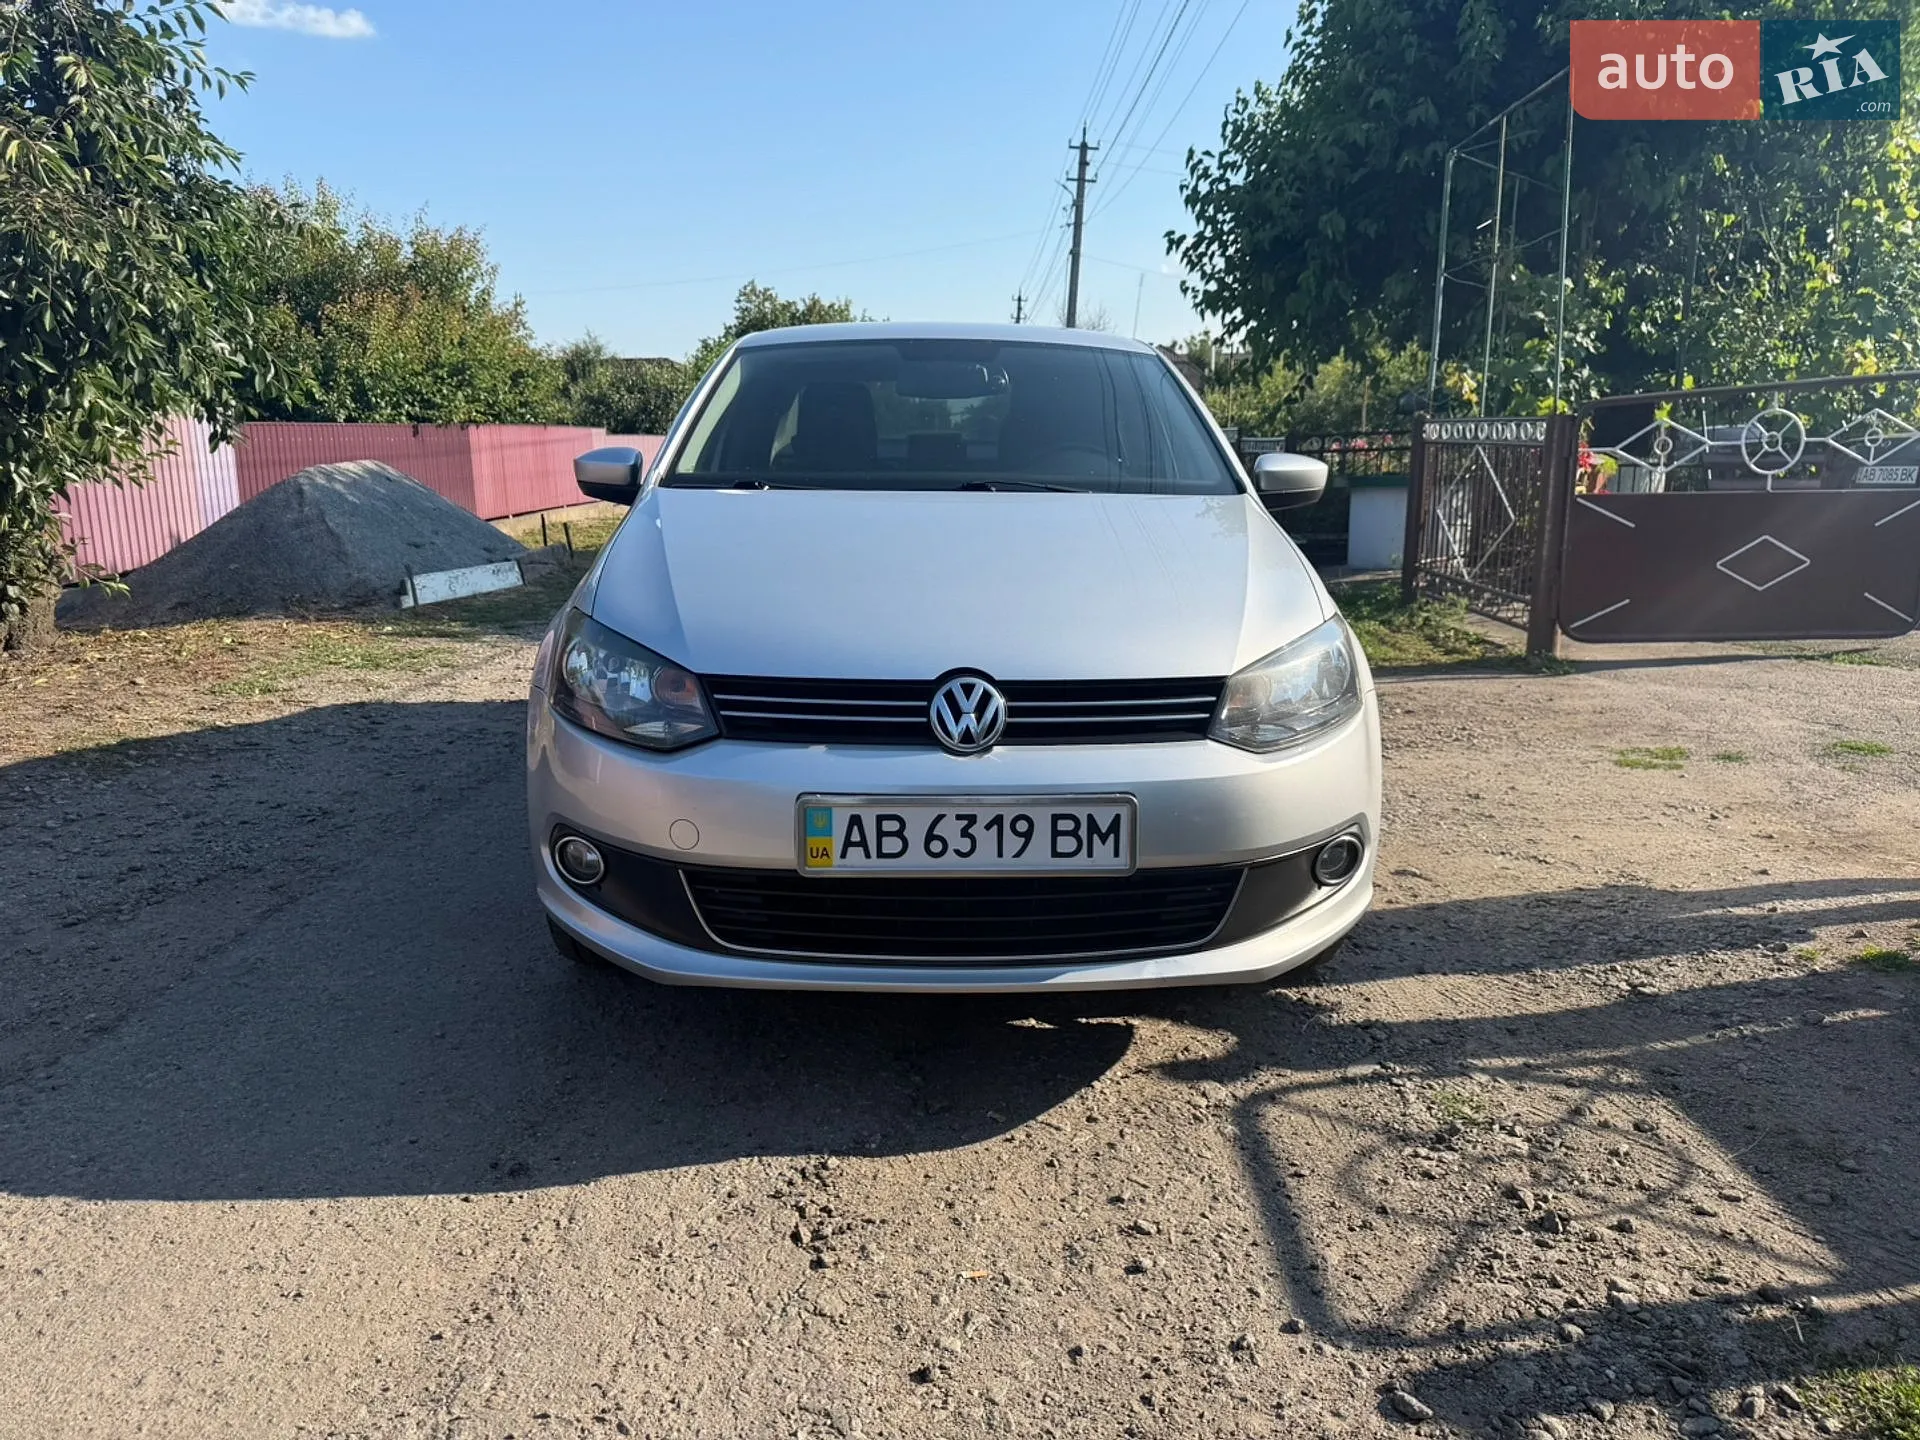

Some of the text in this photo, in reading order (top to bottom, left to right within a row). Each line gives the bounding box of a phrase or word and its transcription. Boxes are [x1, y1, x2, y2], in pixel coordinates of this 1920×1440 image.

[1900, 467, 1917, 481] BK
[839, 813, 1122, 859] AB 6319 BM
[809, 846, 830, 859] UA
